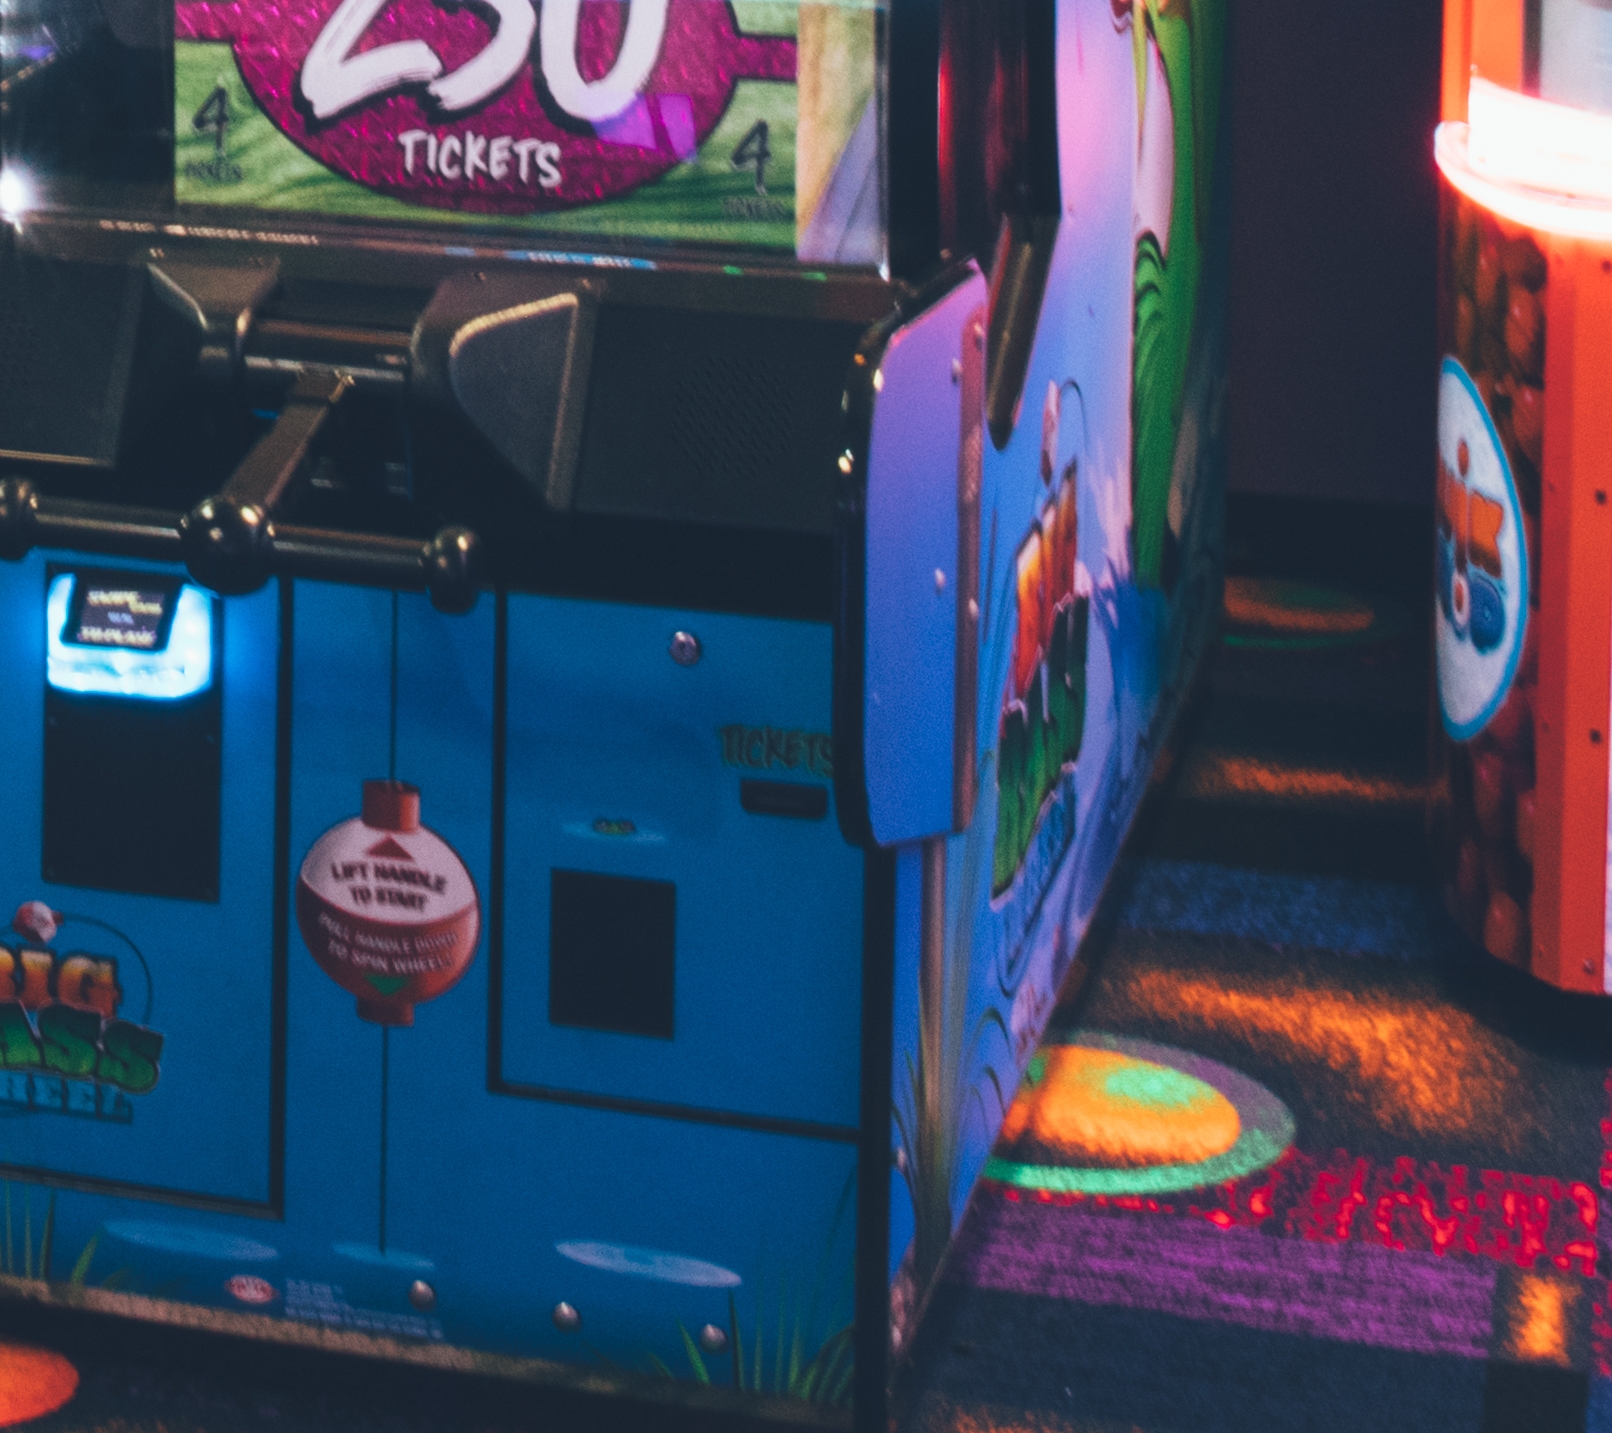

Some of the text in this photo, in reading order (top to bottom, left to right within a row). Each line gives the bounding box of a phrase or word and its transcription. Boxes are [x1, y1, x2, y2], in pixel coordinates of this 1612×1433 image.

[193, 86, 230, 149] 4
[397, 127, 563, 187] TICKETS
[732, 119, 773, 187] 4
[330, 861, 447, 895] LIFT HANDLE
[349, 887, 372, 906] TO
